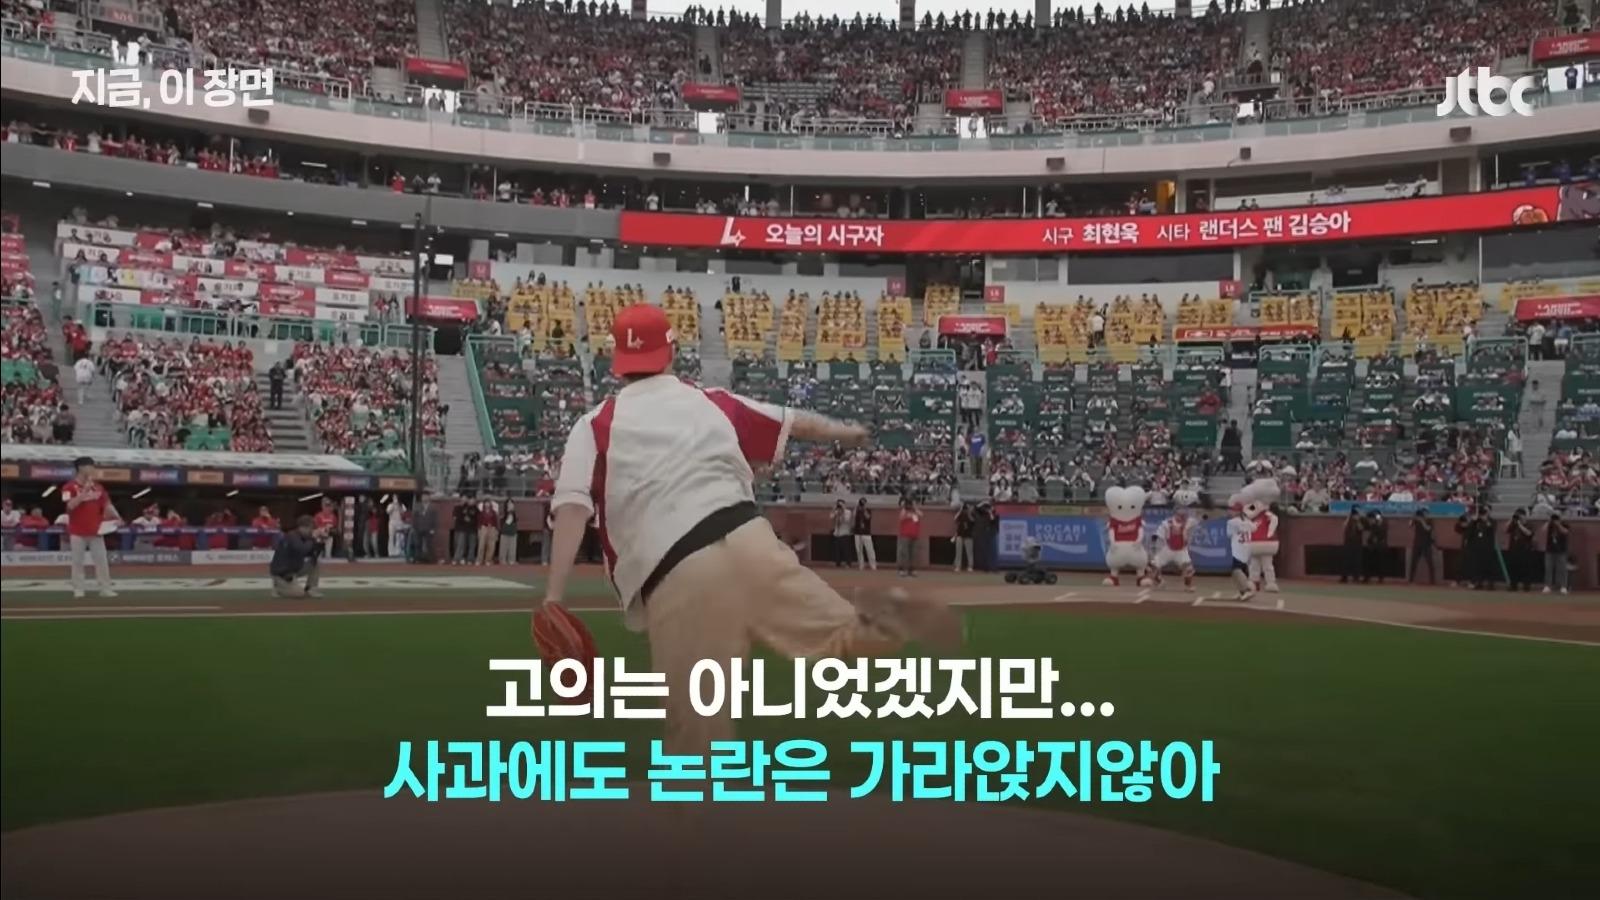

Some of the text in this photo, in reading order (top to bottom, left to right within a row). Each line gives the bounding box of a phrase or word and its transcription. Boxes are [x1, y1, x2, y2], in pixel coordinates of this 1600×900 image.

[765, 223, 885, 247] 오늘의 시구자
[1042, 209, 1352, 245] 시구 최현욱 시타 랜더스 팬 김승아
